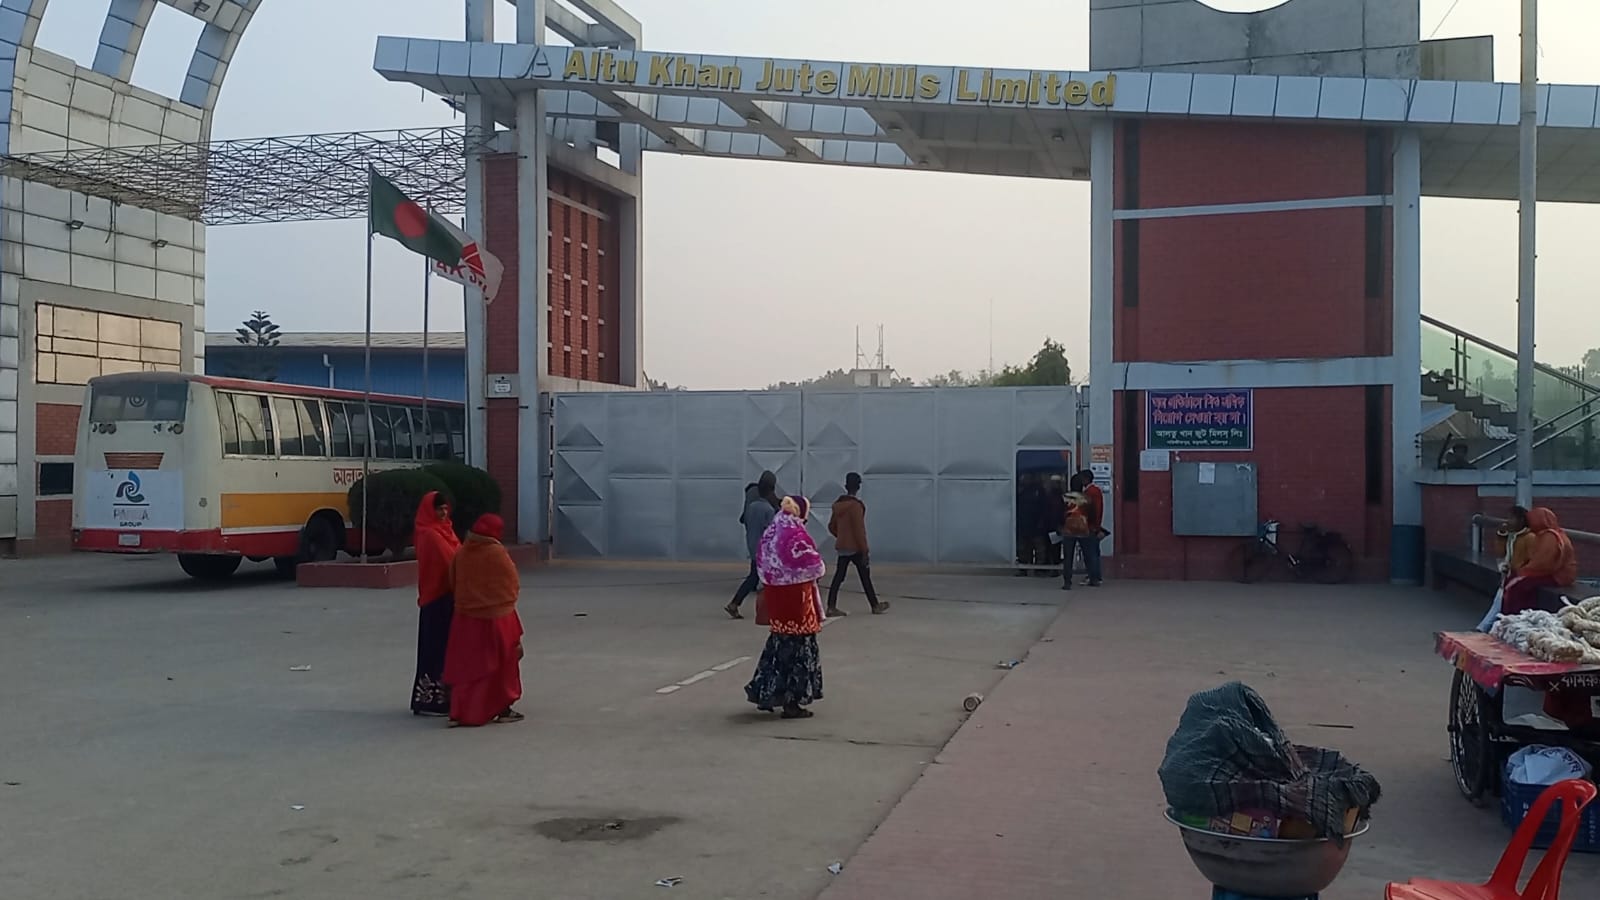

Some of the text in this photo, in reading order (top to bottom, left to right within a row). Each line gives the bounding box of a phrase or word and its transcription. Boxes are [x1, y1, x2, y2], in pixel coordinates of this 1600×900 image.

[564, 49, 1118, 107] Altu Khan Jute Mills Limited
